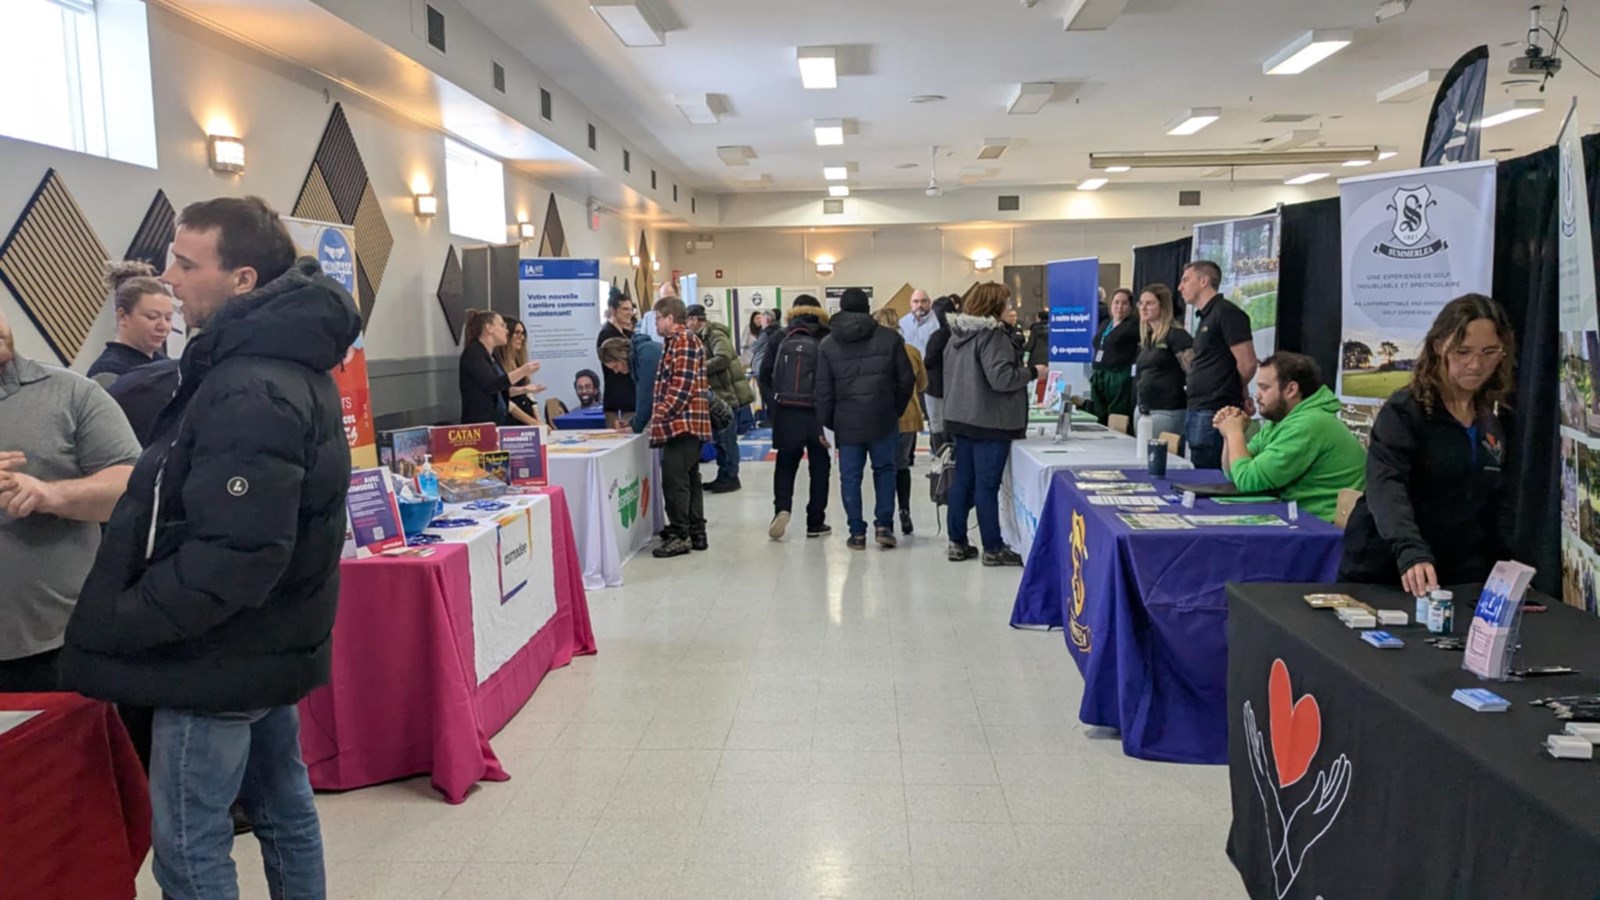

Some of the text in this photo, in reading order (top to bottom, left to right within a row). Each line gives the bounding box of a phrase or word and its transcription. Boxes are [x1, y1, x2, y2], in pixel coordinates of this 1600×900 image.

[1388, 246, 1434, 257] SUMMERLEA
[448, 429, 481, 441] CATAN
[364, 475, 380, 483] AVEC
[504, 543, 527, 566] asmodee
